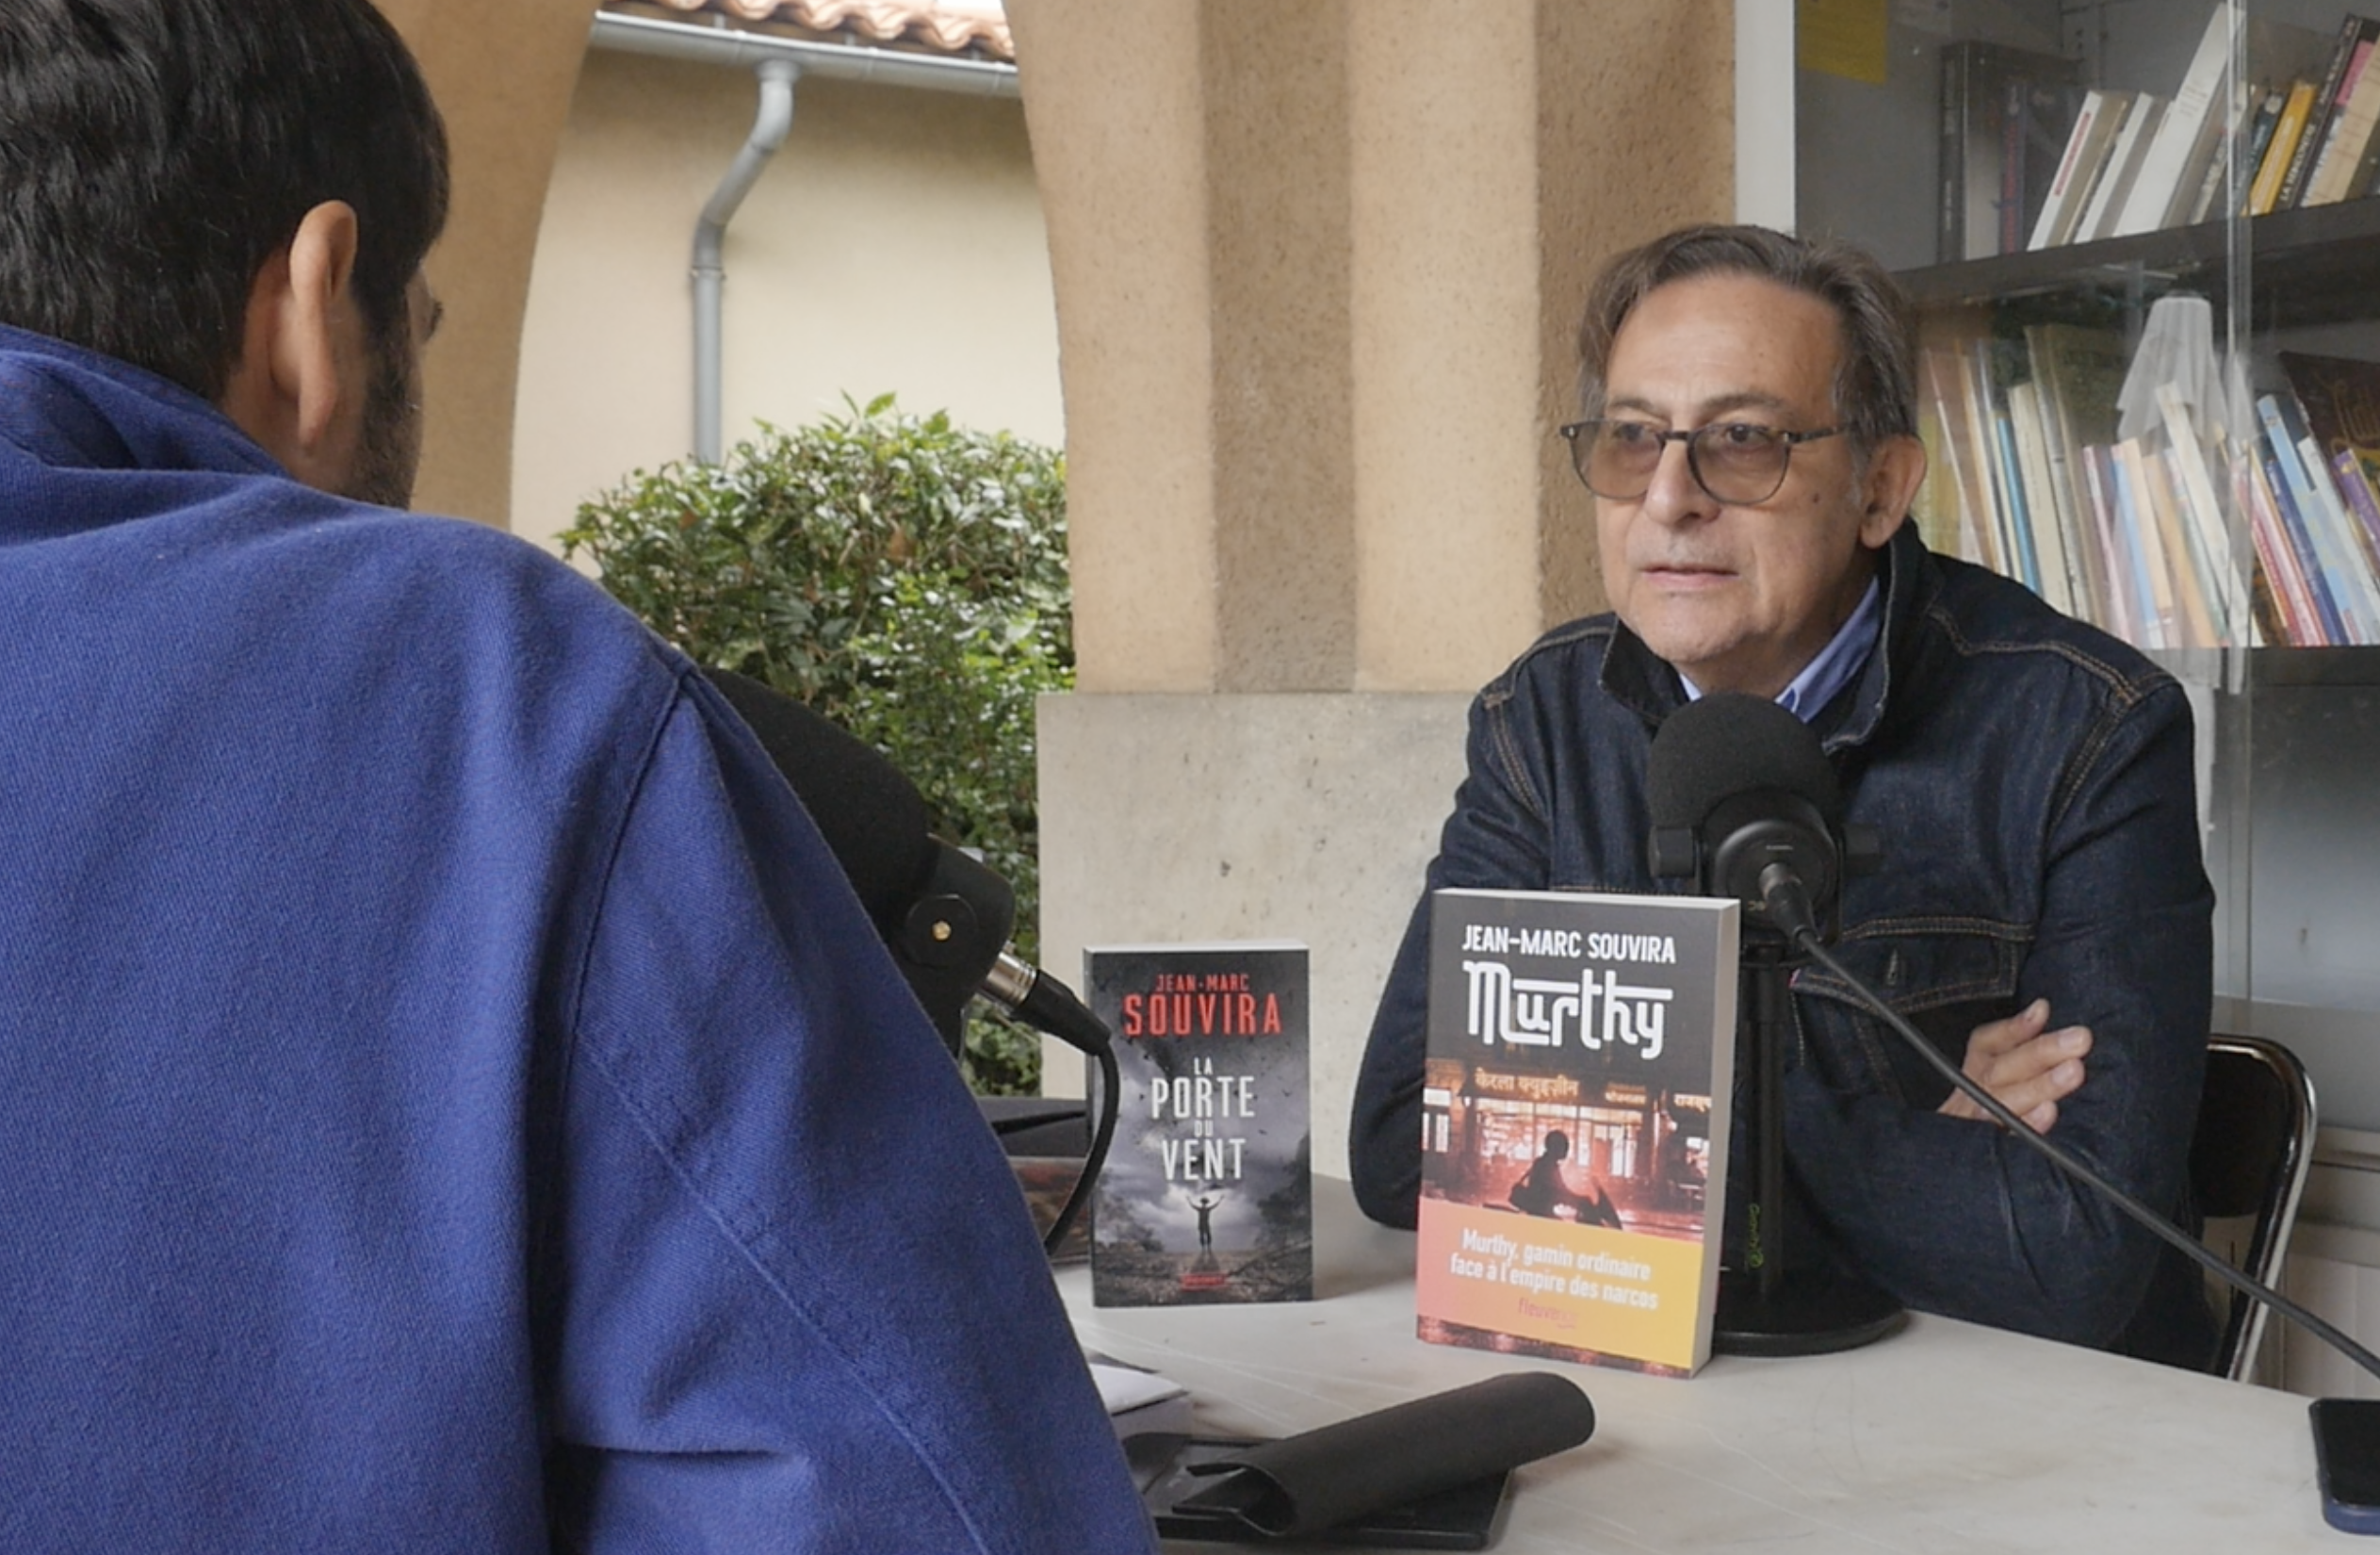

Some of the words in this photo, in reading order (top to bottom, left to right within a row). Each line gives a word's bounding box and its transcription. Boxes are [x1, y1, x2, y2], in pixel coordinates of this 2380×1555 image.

[1462, 925, 1582, 958] JEAN-MARC
[1588, 934, 1676, 964] SOUVIRA
[1156, 974, 1249, 991] JEAN-MARC
[1123, 992, 1281, 1035] SOUVIRA
[1462, 960, 1673, 1059] Murthy
[1194, 1057, 1213, 1075] LA
[1151, 1075, 1255, 1119] PORTE
[1194, 1120, 1214, 1138] DU
[1161, 1138, 1247, 1180] VENT
[1450, 1252, 1483, 1278] face
[1486, 1259, 1497, 1281] à
[1500, 1261, 1565, 1294] l'empire
[1569, 1273, 1599, 1299] des
[1603, 1286, 1659, 1310] narcos
[1523, 1244, 1573, 1268] gamin
[1577, 1252, 1651, 1280] ordinaire
